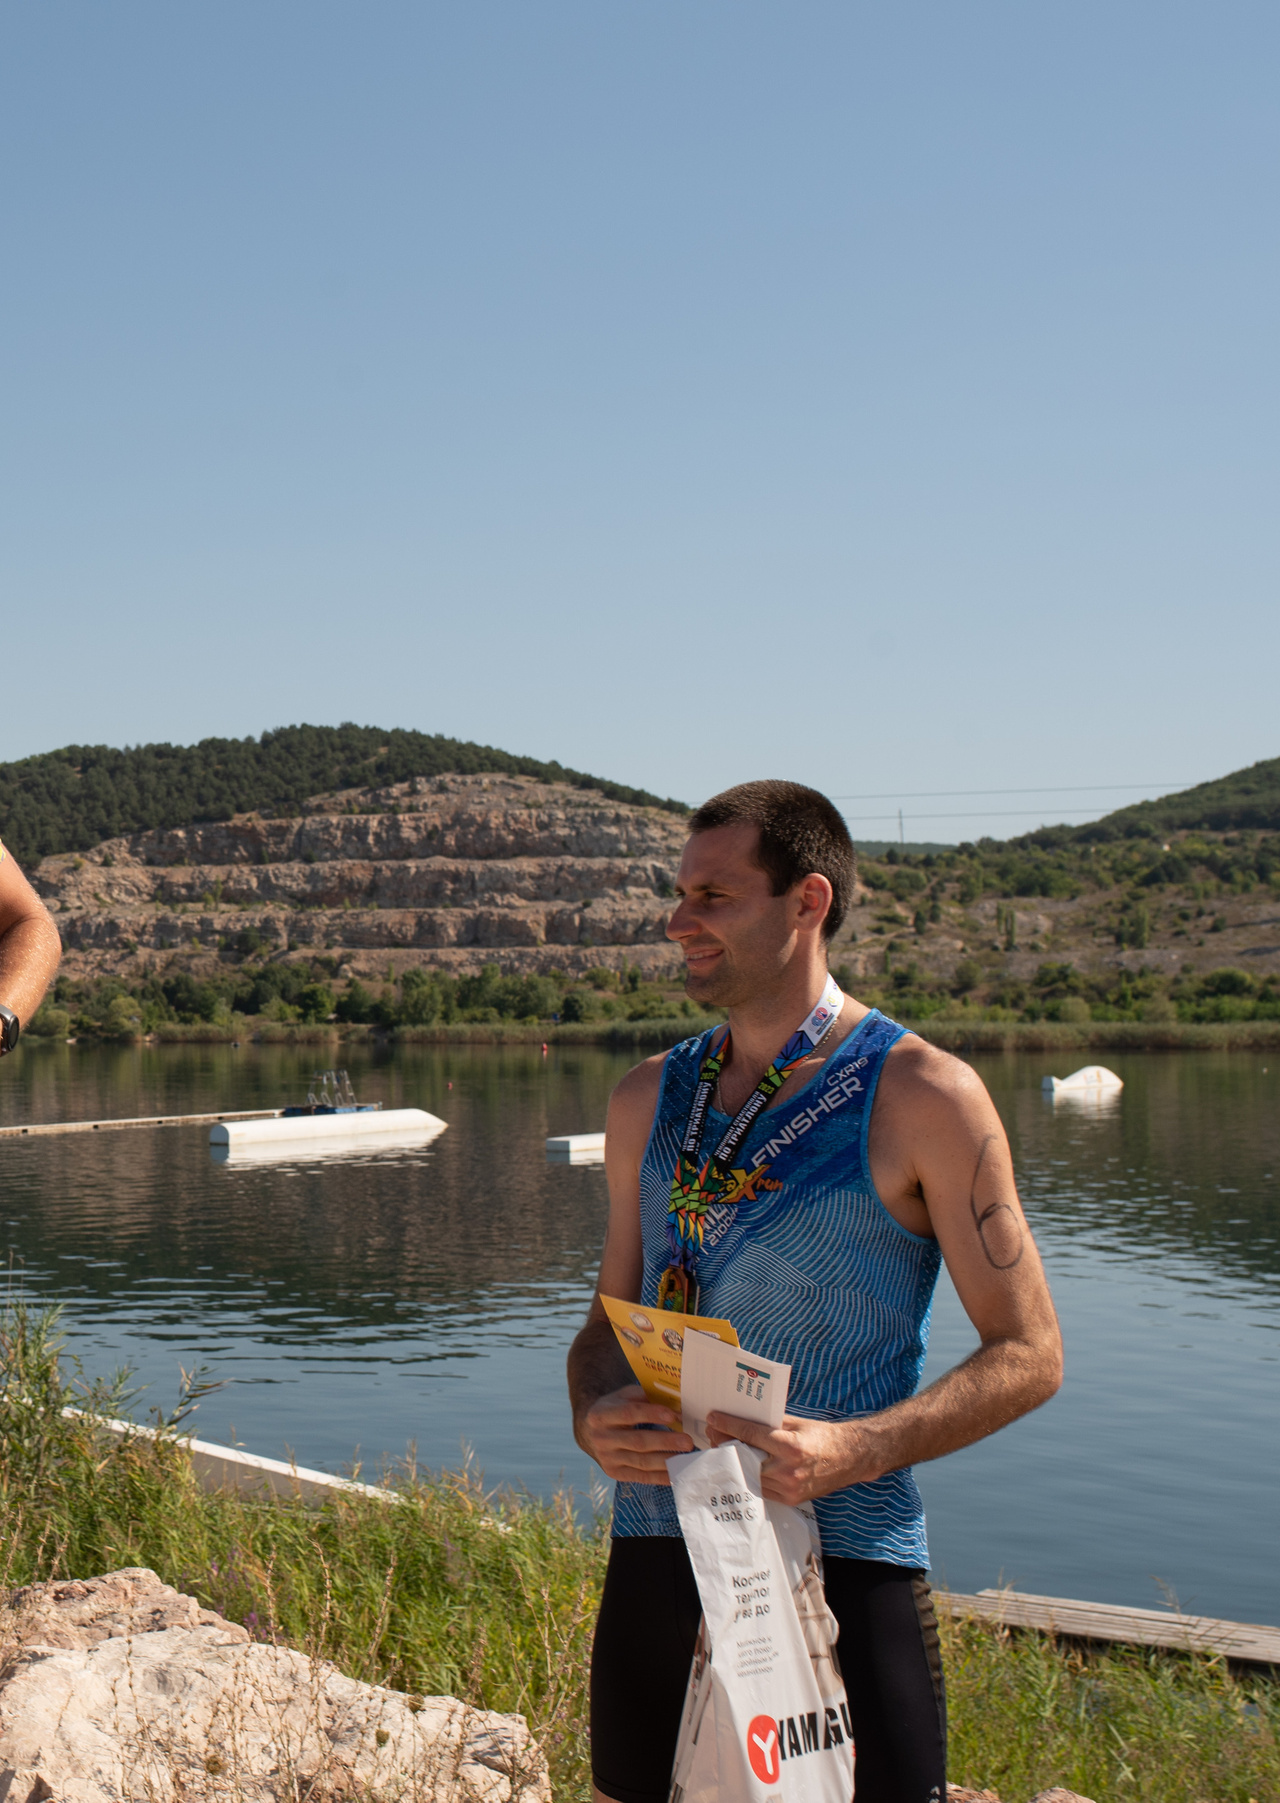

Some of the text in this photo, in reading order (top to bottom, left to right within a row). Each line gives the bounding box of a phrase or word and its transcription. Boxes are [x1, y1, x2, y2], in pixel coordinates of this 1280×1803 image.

[686, 1082, 712, 1152] ПО ТРИАТЛОНУ
[718, 1146, 732, 1161] ПО
[728, 1093, 767, 1146] ТРИАТЛОНУ
[751, 1076, 865, 1168] FINISHER
[710, 1496, 719, 1507] 8
[720, 1492, 742, 1506] 800
